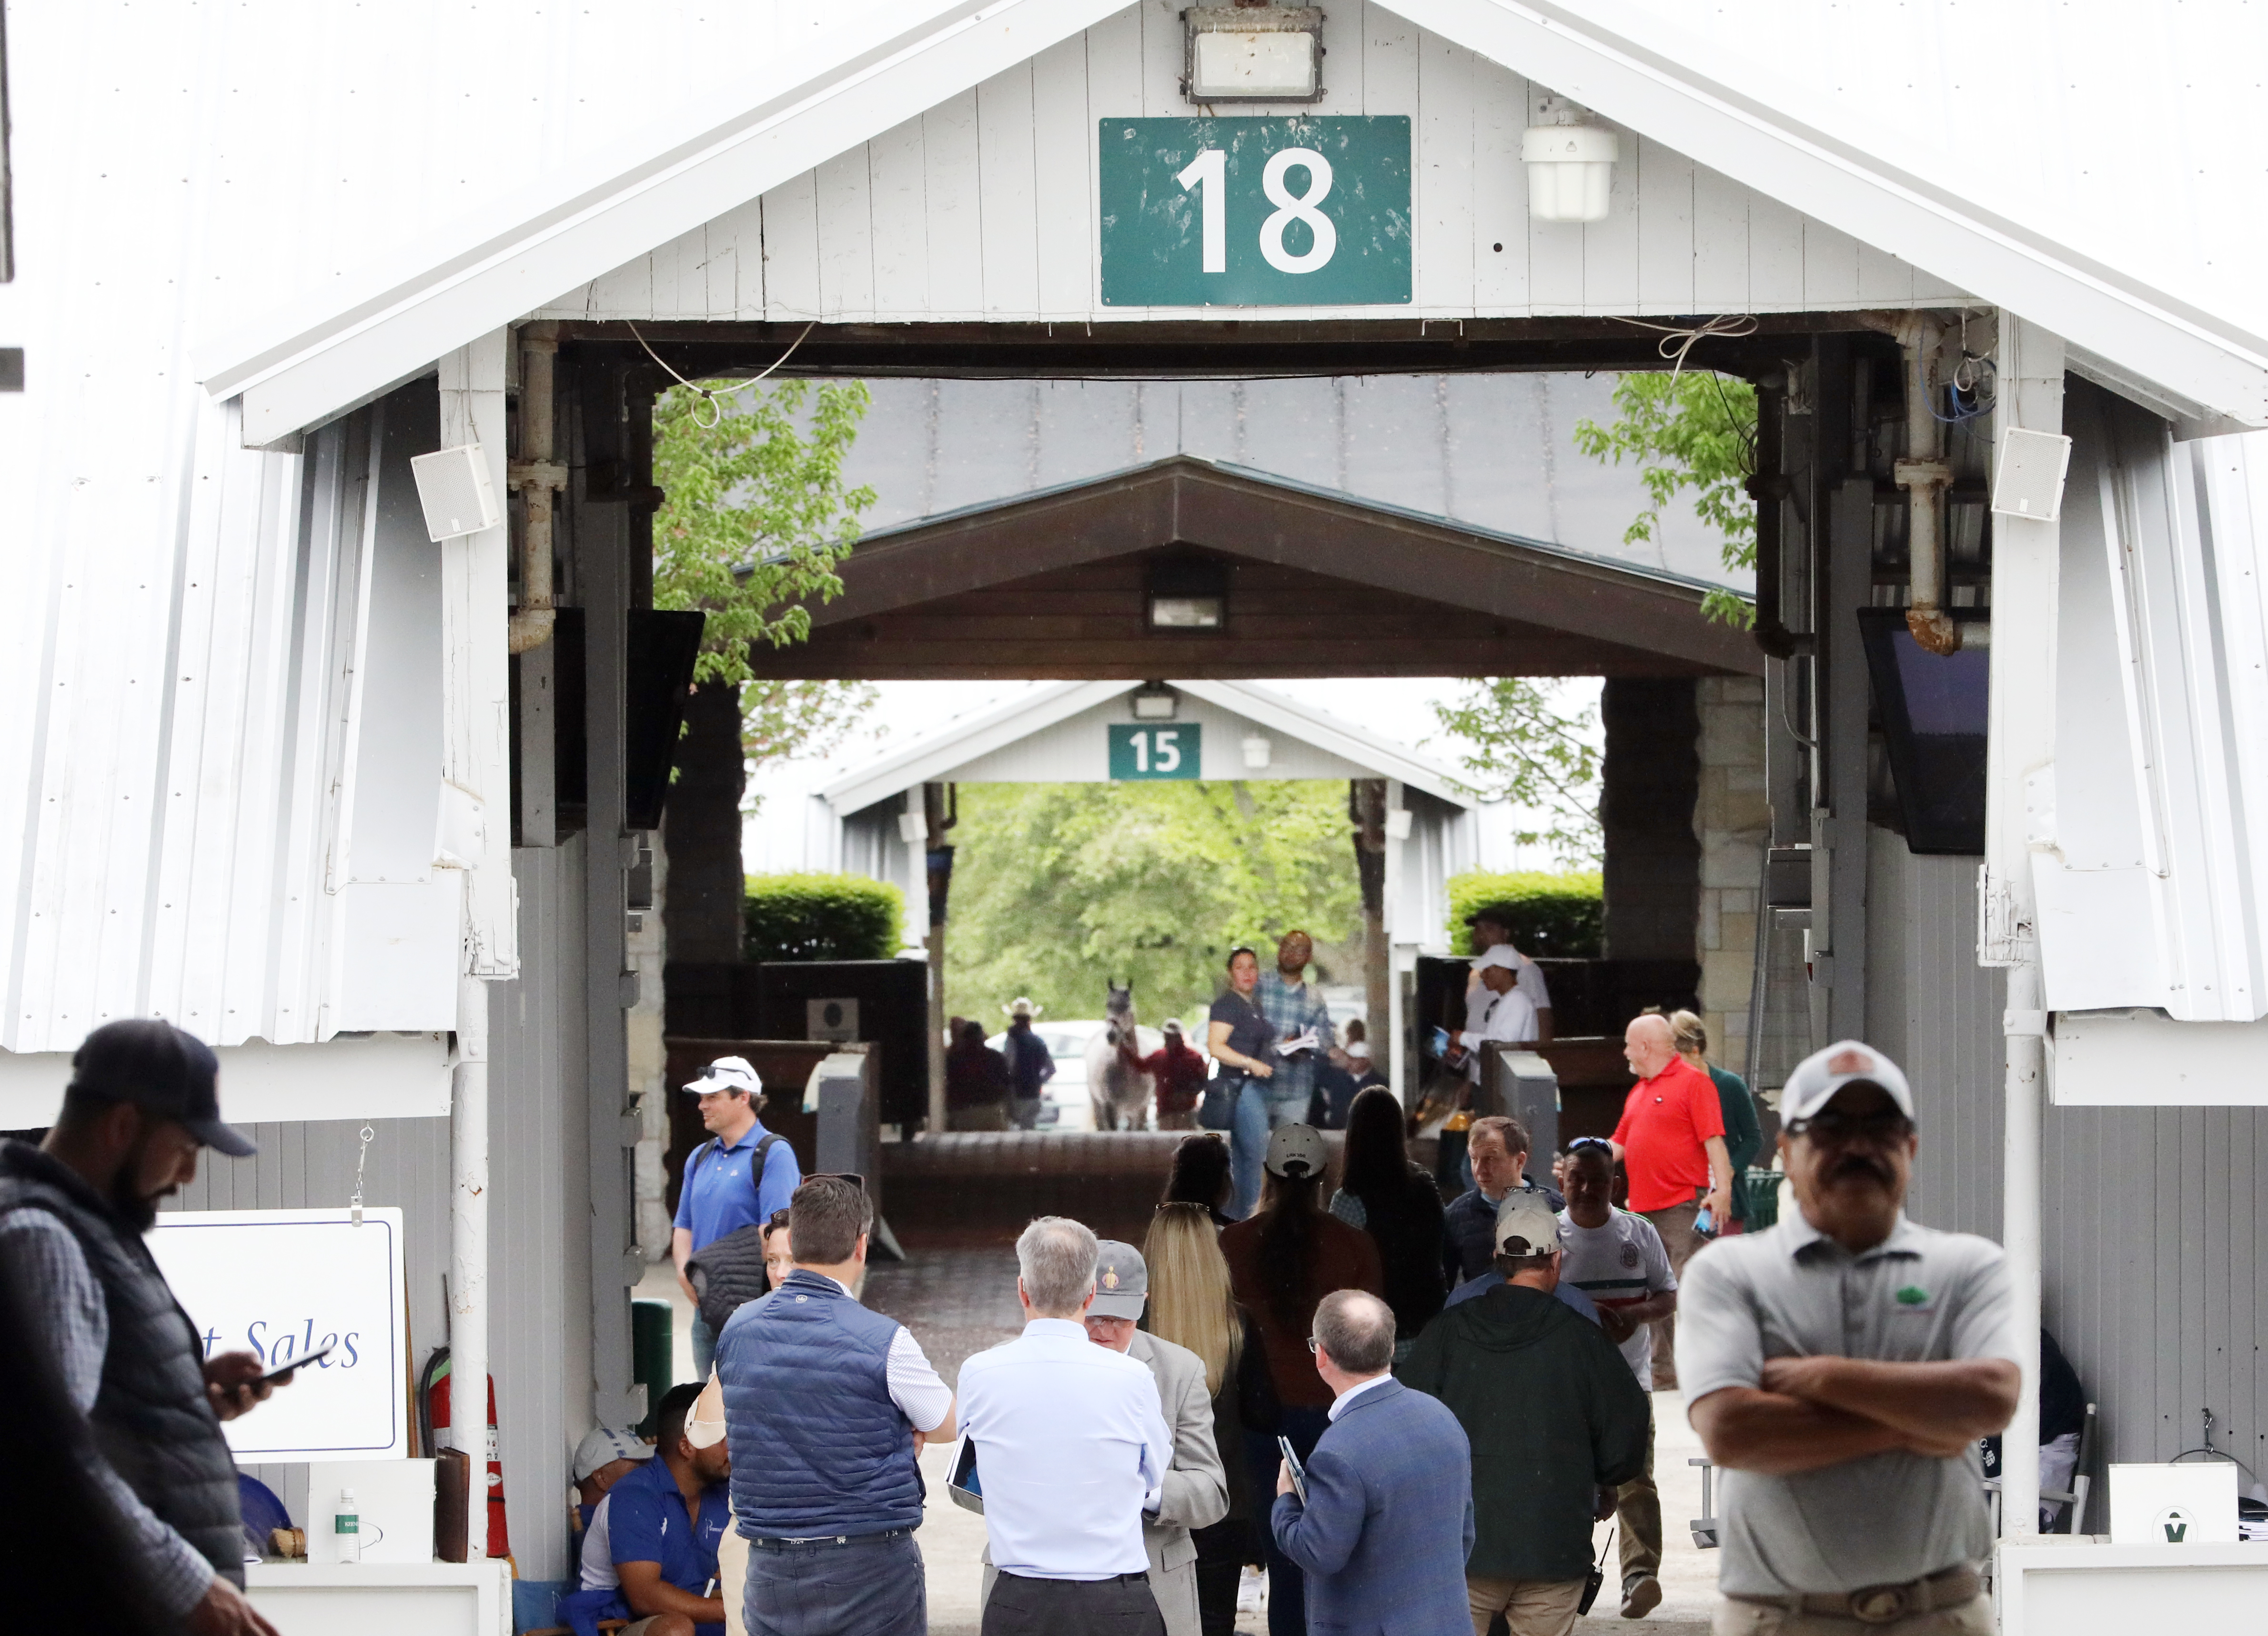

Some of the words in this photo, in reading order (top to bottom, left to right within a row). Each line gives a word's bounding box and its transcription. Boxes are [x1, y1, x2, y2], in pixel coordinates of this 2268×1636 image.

[1176, 147, 1336, 274] 18
[1129, 731, 1181, 772] 15
[247, 1318, 359, 1368] Sales
